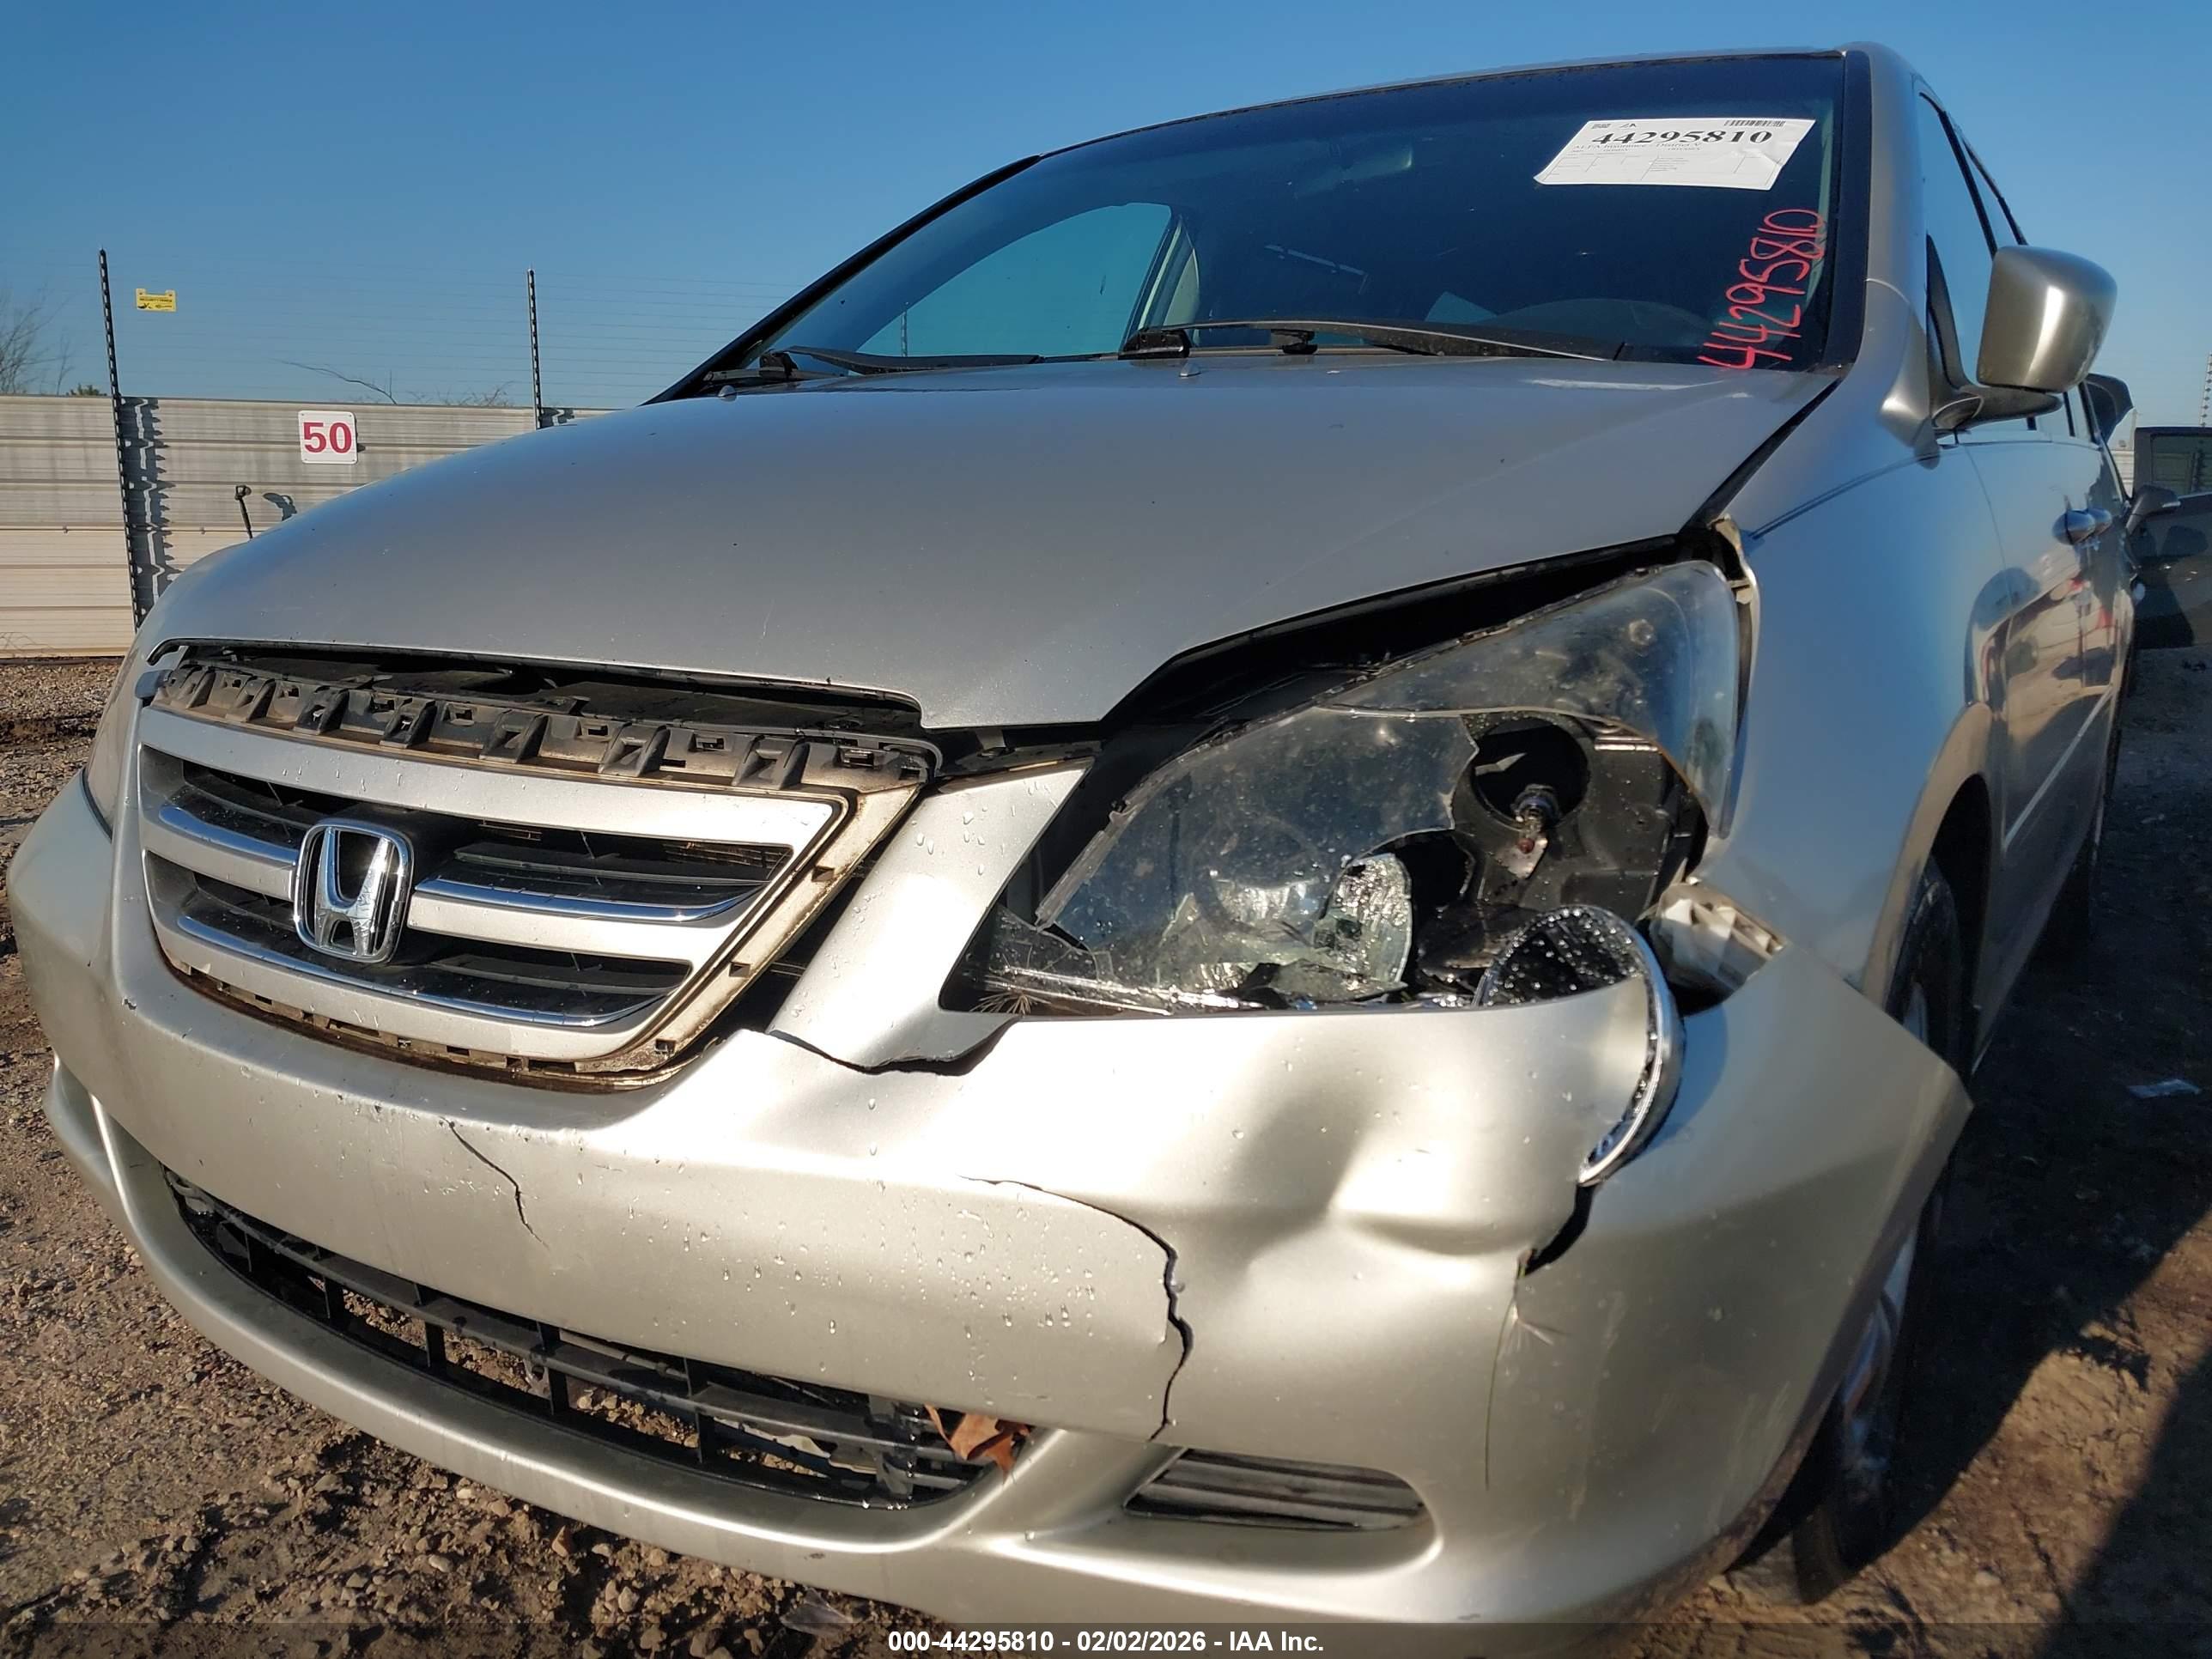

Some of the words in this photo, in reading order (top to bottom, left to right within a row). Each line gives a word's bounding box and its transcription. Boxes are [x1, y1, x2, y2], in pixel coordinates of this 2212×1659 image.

[1591, 130, 1773, 145] 44295810
[1698, 209, 1826, 370] 44295810
[303, 422, 352, 453] 50
